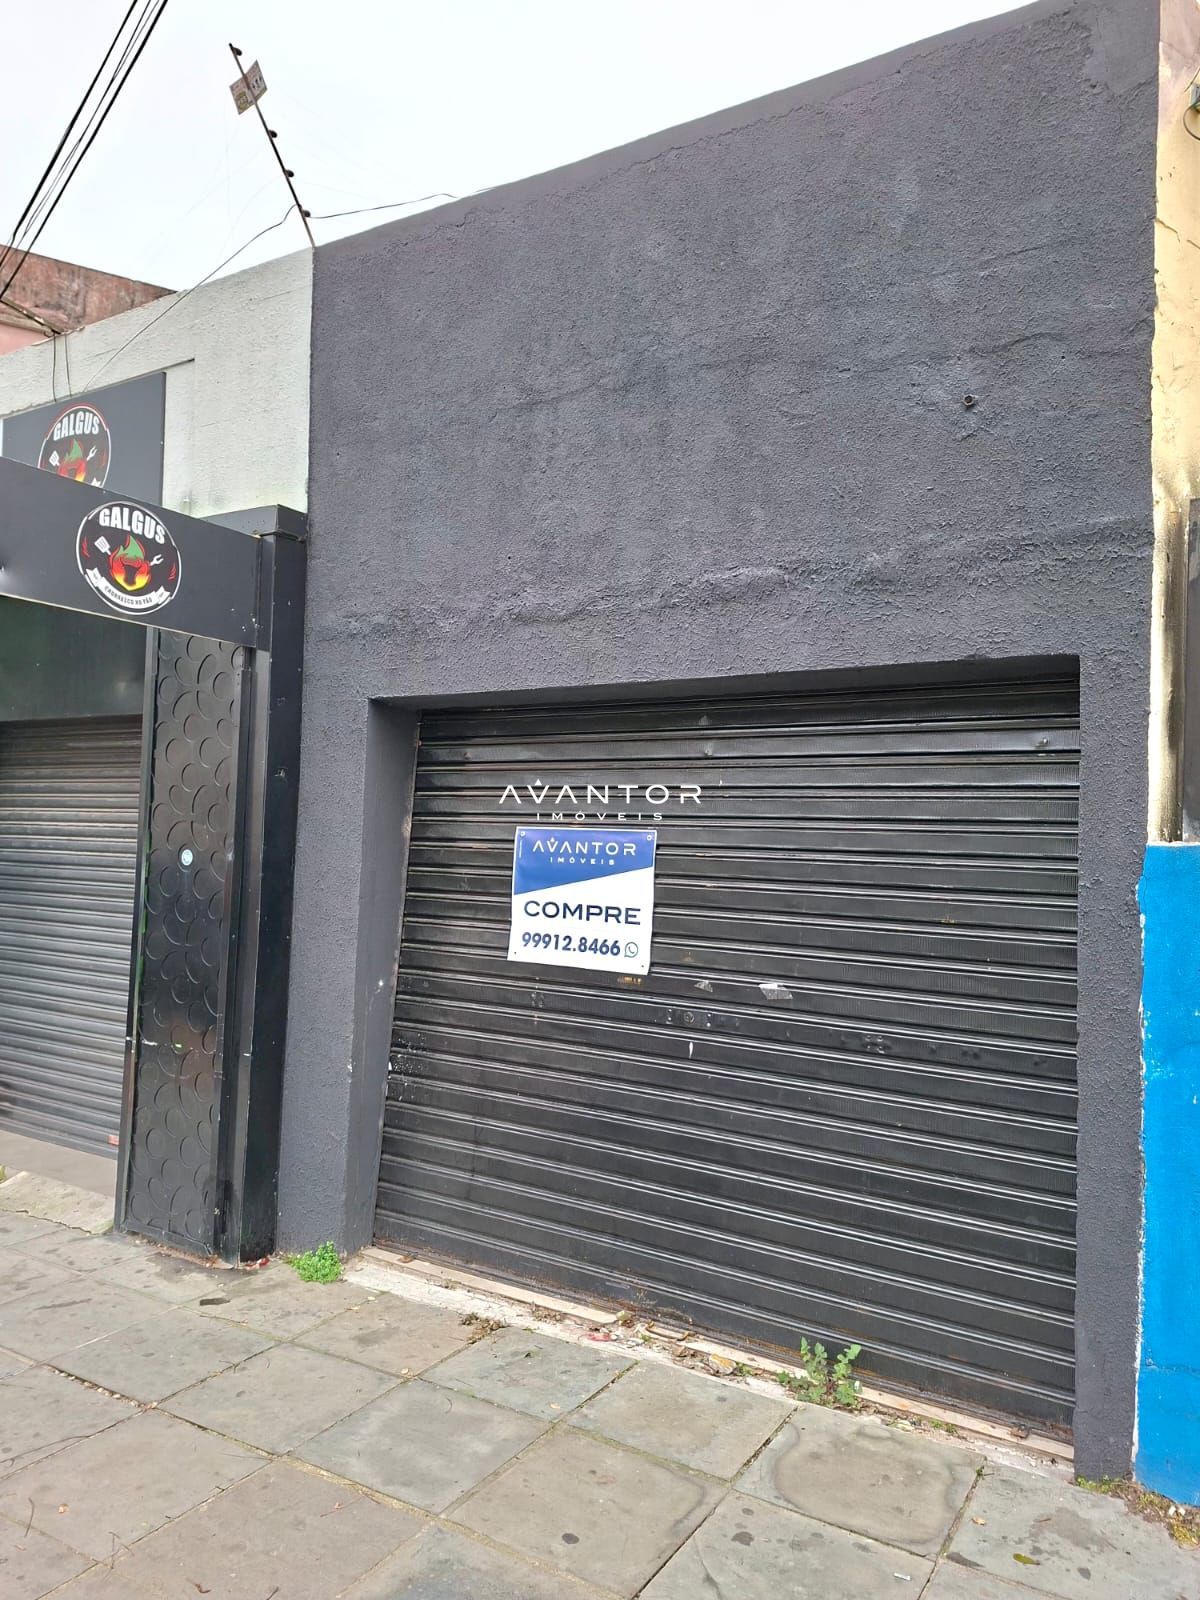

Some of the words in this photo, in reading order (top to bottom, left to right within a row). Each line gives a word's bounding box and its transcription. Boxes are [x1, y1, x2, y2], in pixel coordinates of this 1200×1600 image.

[53, 410, 100, 441] GALGUS
[99, 506, 166, 545] GALGUS
[532, 837, 637, 856] AVANTOR
[549, 856, 616, 866] IMÓVEIS
[523, 900, 642, 926] COMPRE
[521, 931, 621, 957] 99912.8466
